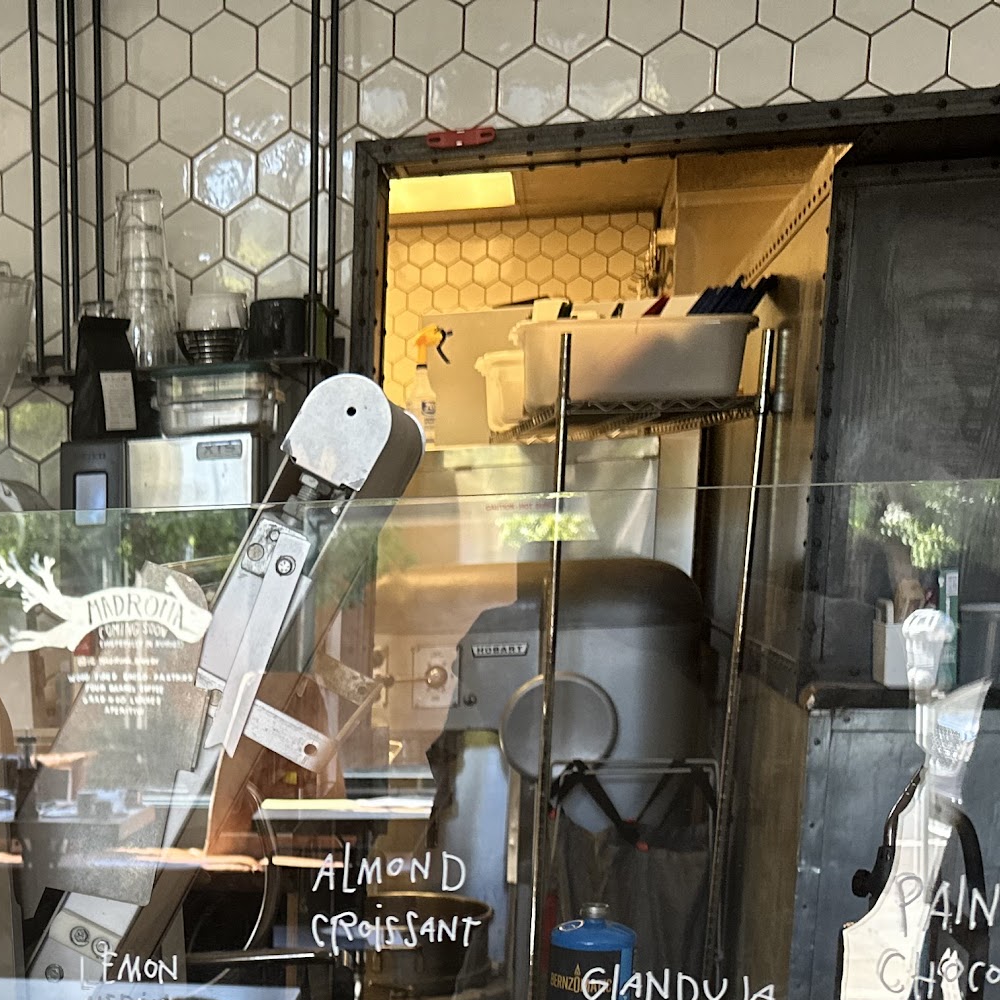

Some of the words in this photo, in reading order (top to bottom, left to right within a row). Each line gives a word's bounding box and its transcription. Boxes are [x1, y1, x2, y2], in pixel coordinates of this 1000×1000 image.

[476, 646, 523, 655] HOBART
[312, 841, 466, 893] ALMOND
[896, 874, 1000, 937] PAIN
[80, 946, 178, 987] LEMON
